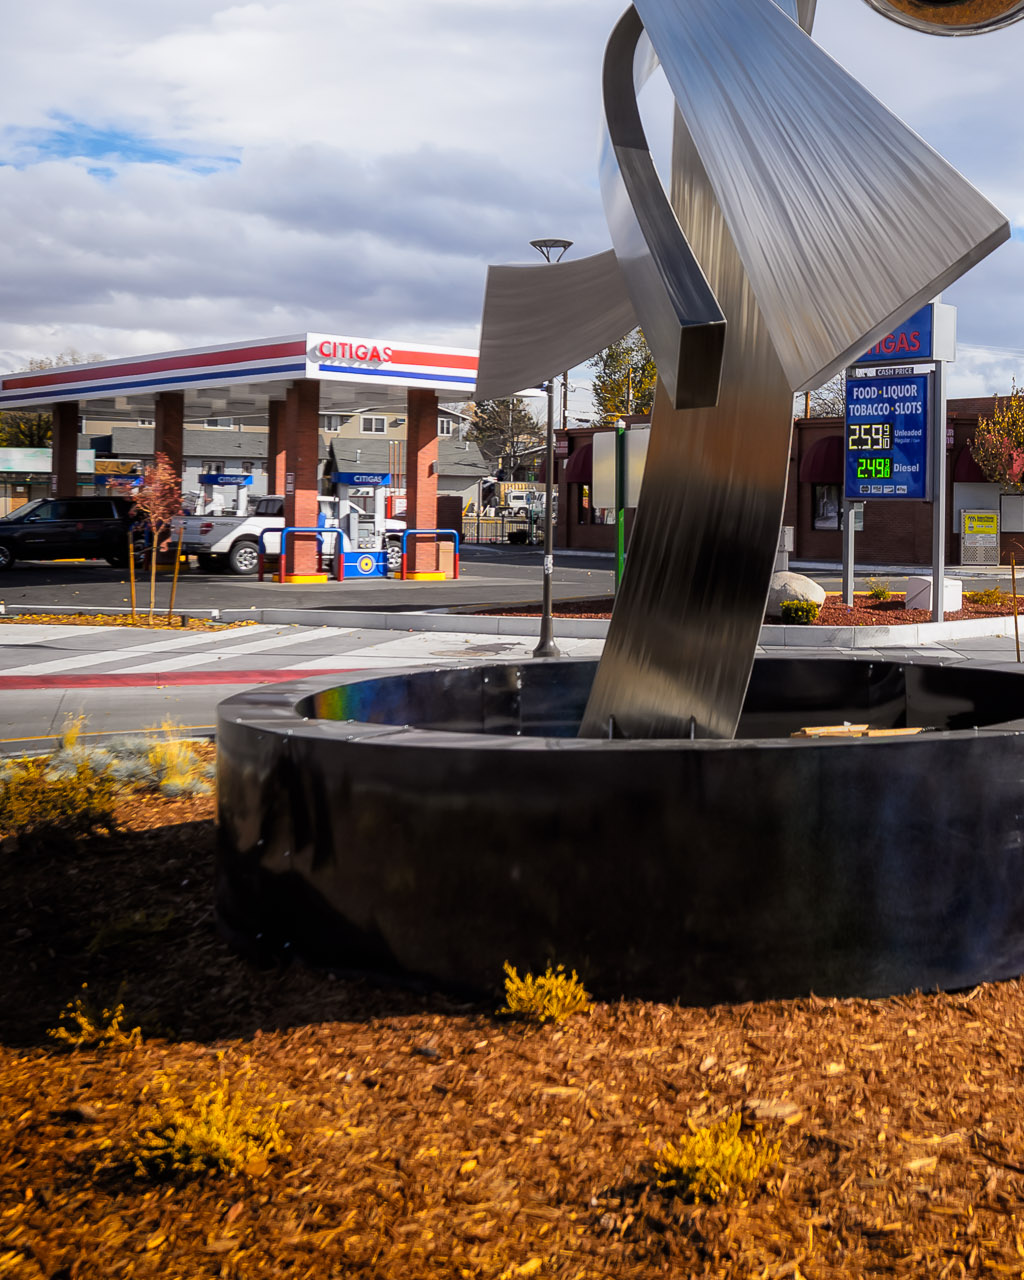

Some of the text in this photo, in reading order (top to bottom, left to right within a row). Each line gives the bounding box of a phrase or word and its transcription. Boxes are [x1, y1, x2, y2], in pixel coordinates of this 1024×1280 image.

[867, 331, 921, 355] IGAS
[319, 340, 392, 363] CITIGAS
[877, 367, 913, 376] CASH PRICE
[853, 384, 918, 400] FOOD LIQUOR
[849, 401, 922, 417] TOBACCO SLOTS
[857, 459, 884, 478] 2.49
[893, 464, 919, 472] Diesel
[354, 475, 383, 483] CITIGAS
